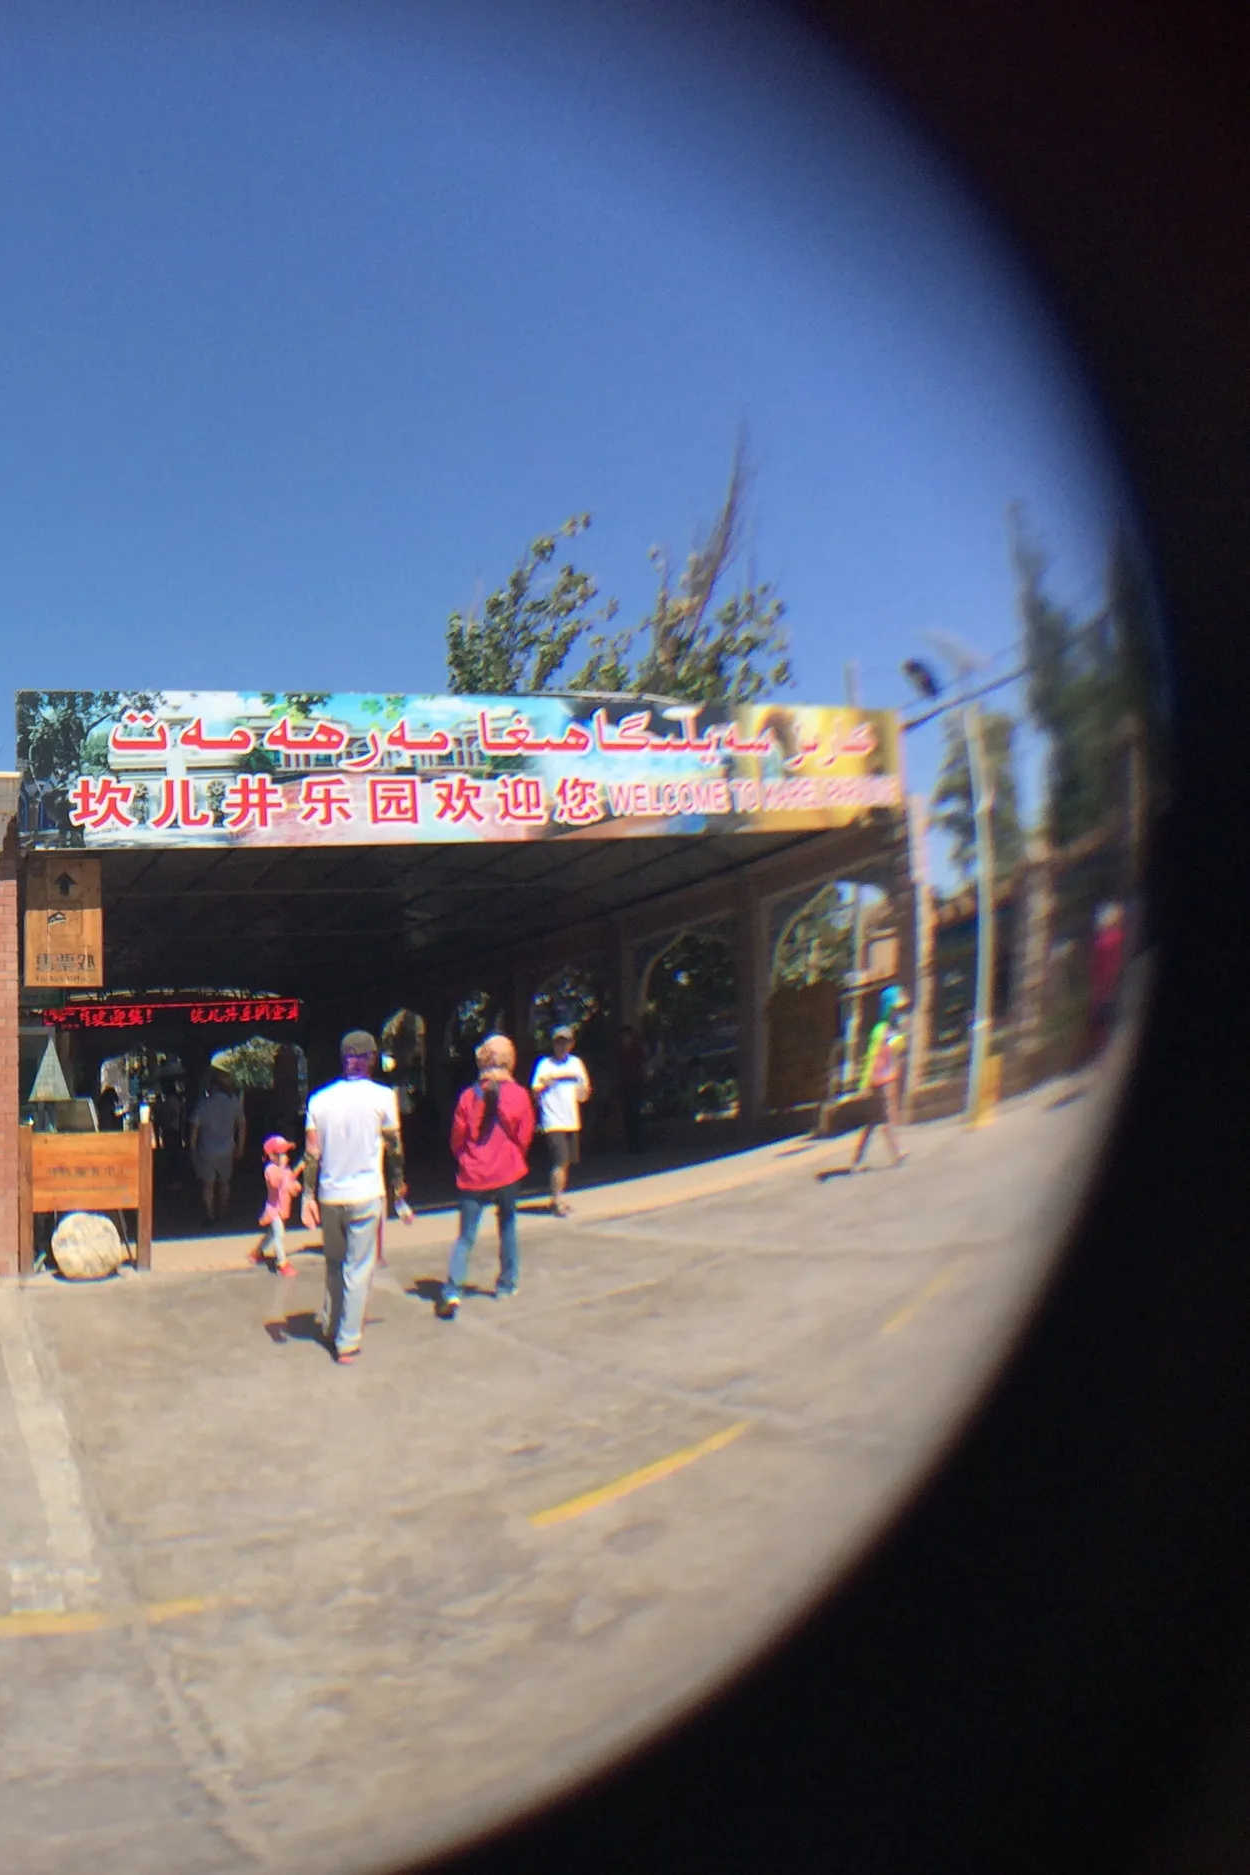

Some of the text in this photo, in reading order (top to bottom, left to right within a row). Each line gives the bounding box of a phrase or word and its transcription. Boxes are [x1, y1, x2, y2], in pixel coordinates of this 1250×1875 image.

[71, 775, 600, 829] 坎儿井乐园欢迎您
[608, 780, 728, 814] WELCOME
[731, 779, 761, 813] TO
